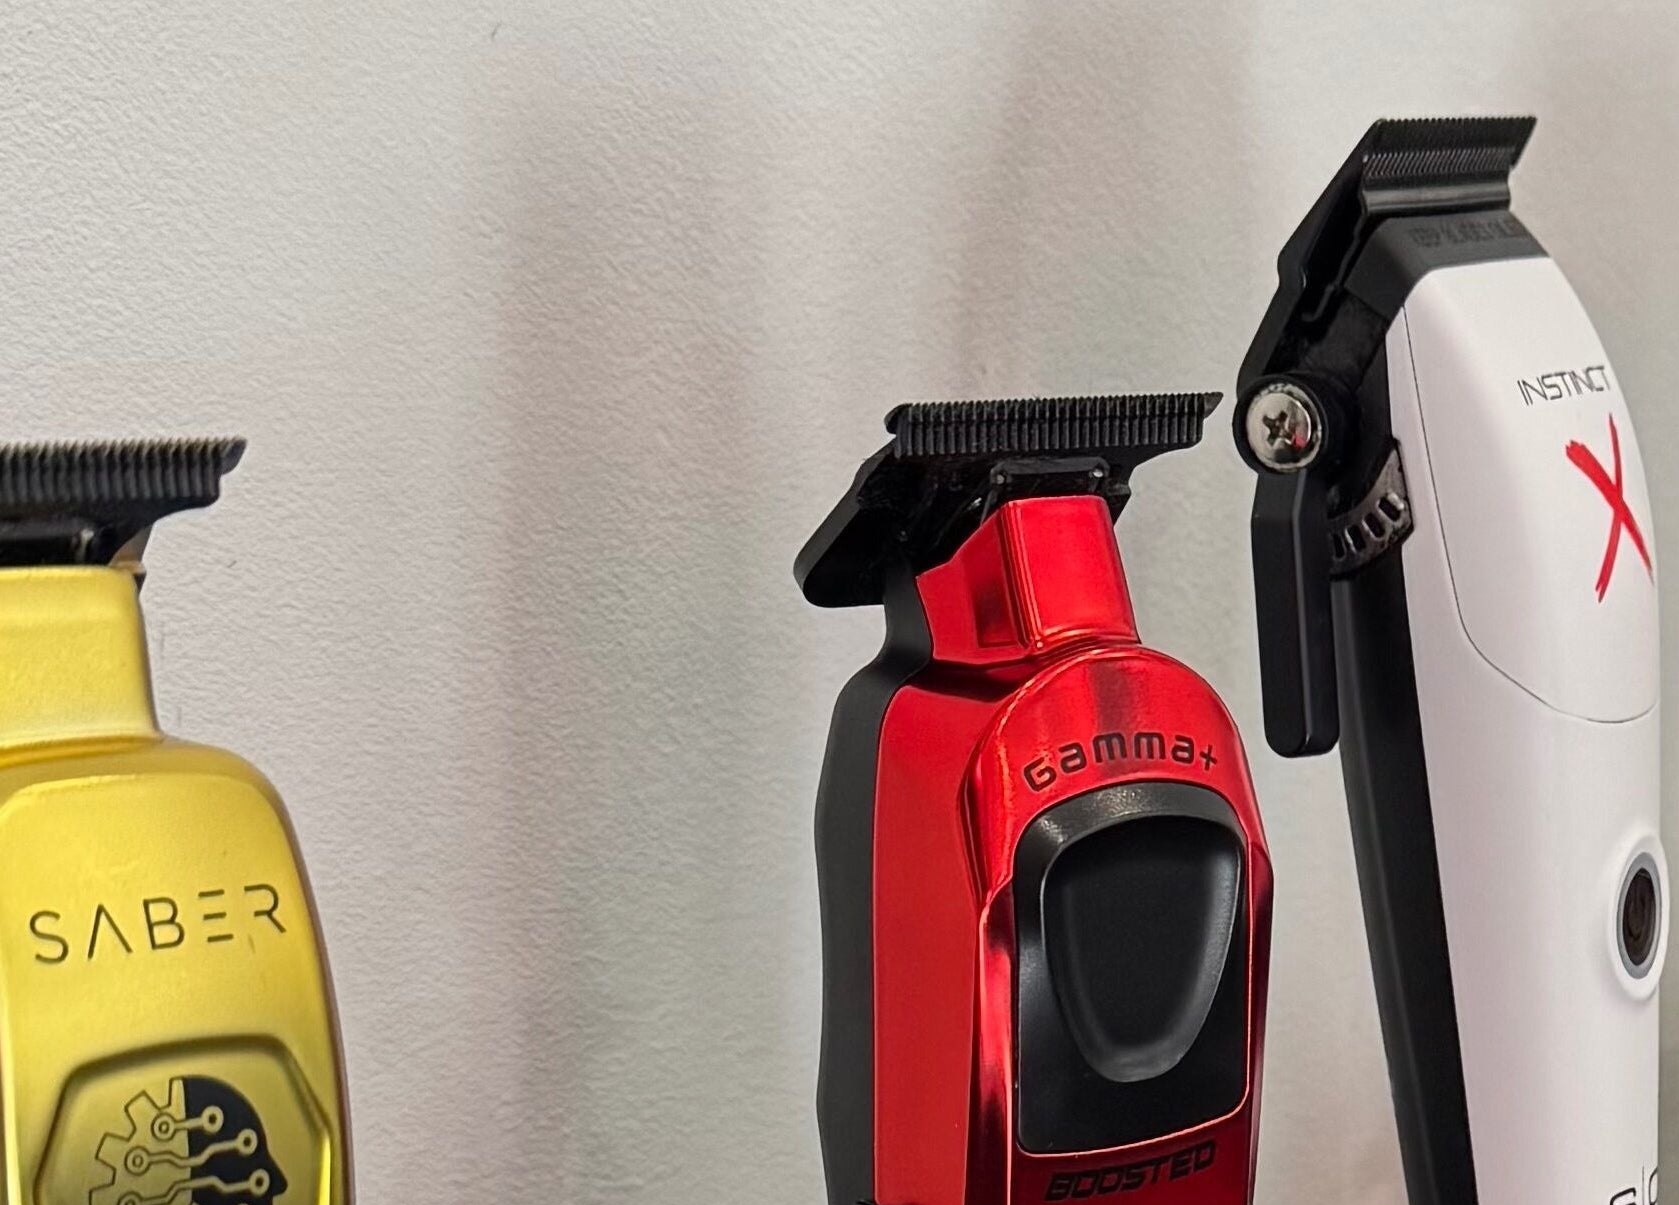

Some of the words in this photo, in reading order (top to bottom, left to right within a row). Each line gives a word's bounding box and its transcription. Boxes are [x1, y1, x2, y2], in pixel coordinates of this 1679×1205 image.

[1516, 365, 1611, 406] INSTINCT
[28, 882, 287, 965] SABER
[1045, 1140, 1217, 1202] BOOSTED
